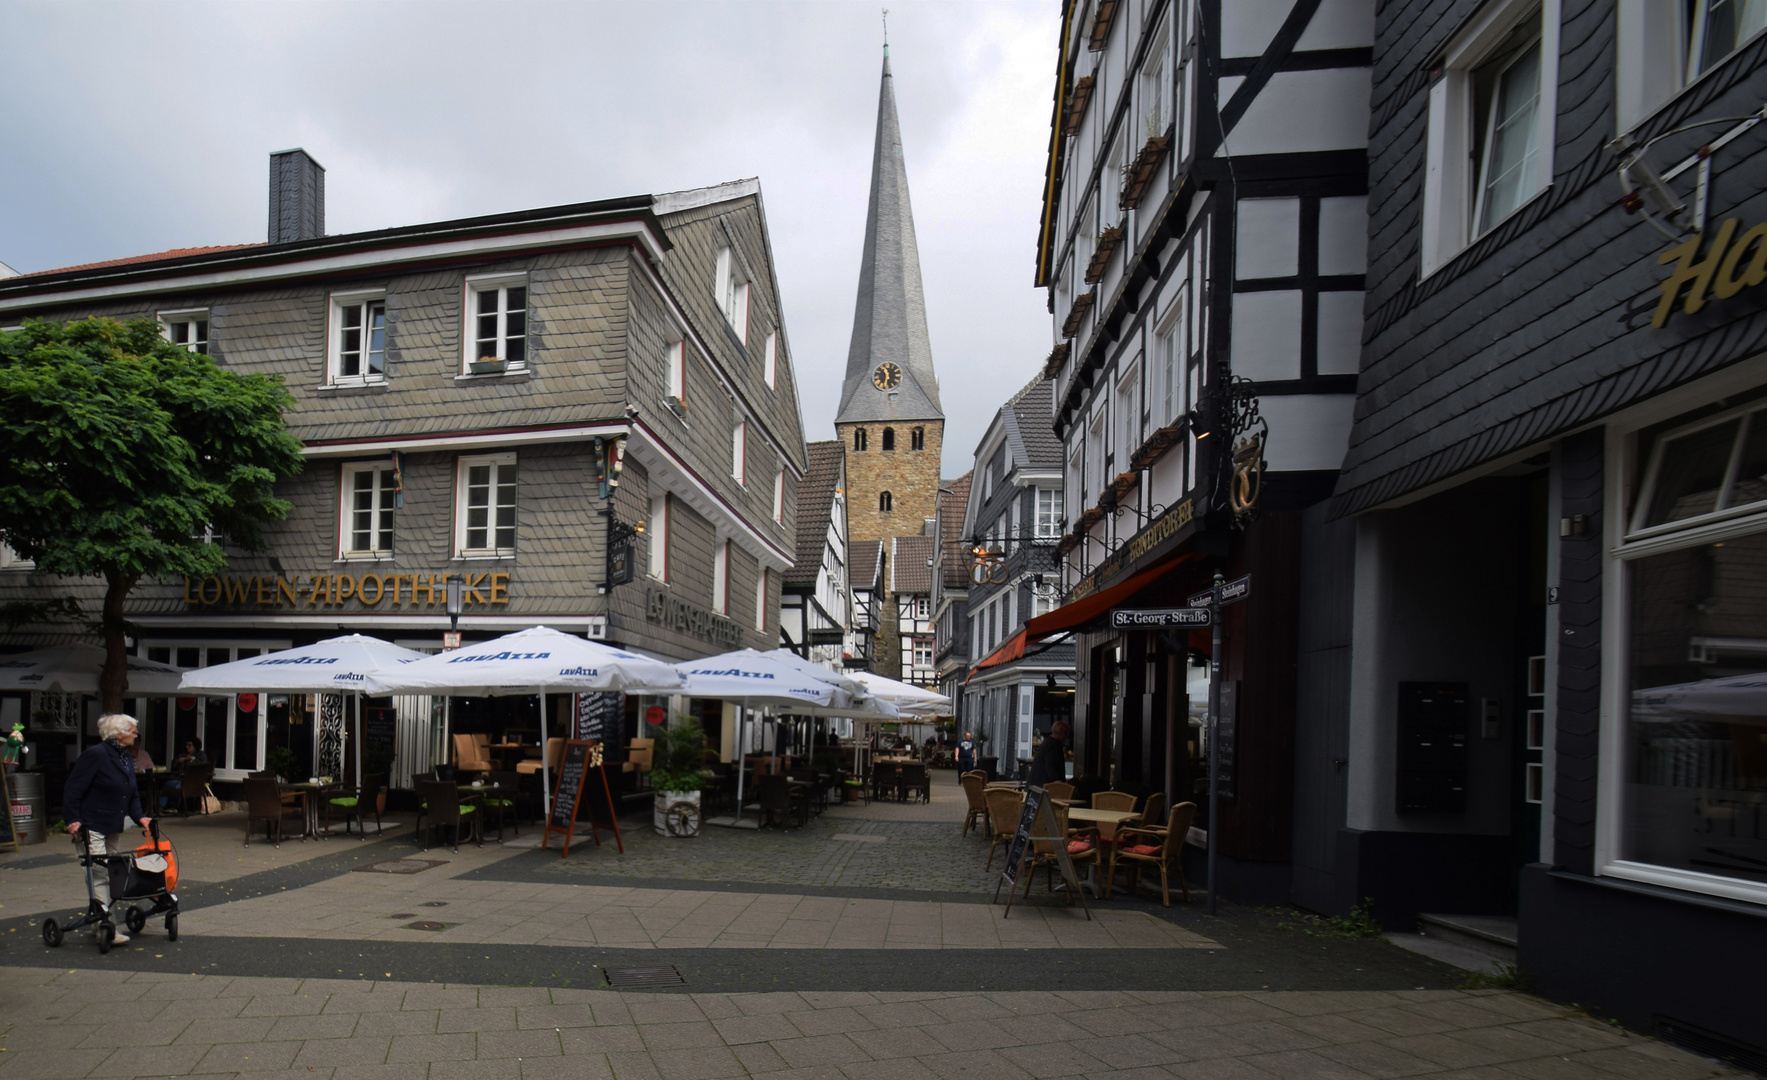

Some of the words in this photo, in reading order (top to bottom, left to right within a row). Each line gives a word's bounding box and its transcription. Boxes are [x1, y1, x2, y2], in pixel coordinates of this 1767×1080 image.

[1129, 498, 1193, 563] KONDITOREI
[1221, 584, 1246, 599] Steinhagen
[1550, 588, 1558, 602] 9
[1116, 610, 1207, 625] St.-Georg-Straße
[253, 656, 340, 666] LAVAZZA
[446, 651, 551, 664] LAVAZZA
[333, 672, 364, 681] LAVAZZA
[560, 666, 598, 677] LAVAZZA
[690, 668, 775, 679] LAVAZZA
